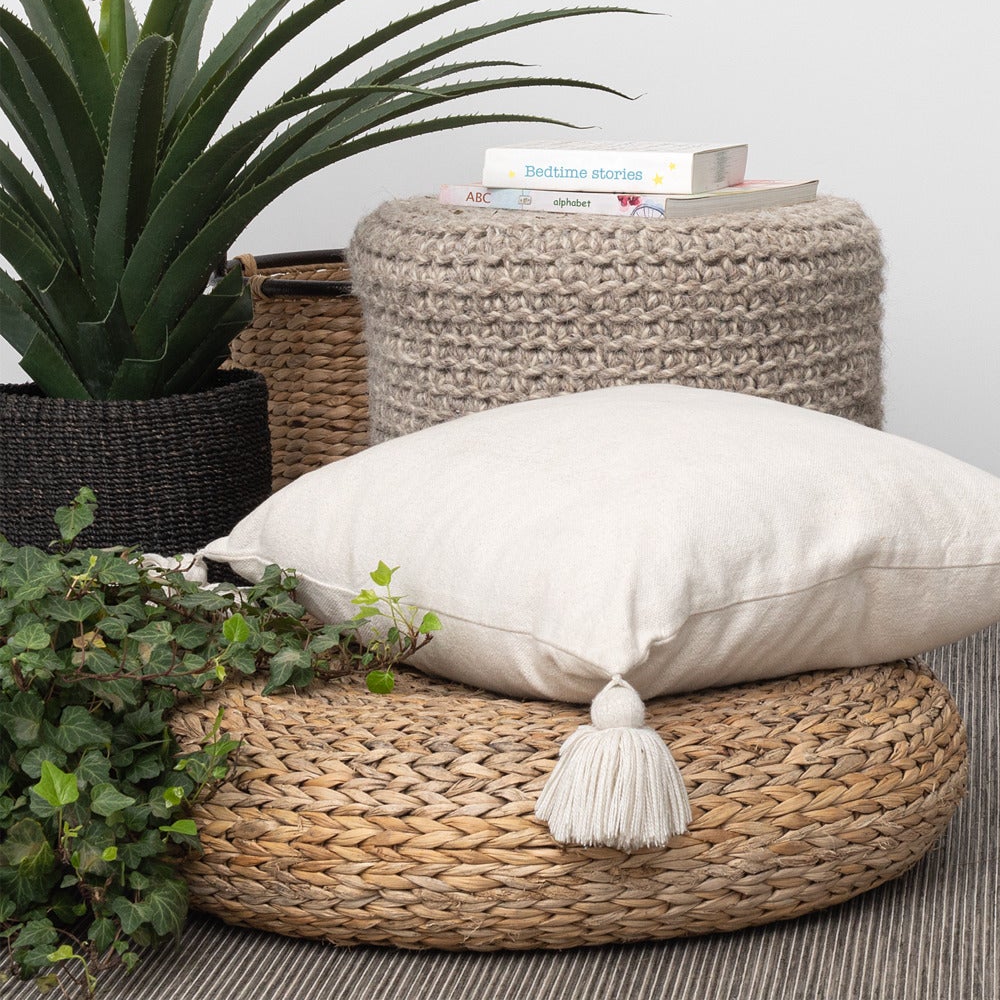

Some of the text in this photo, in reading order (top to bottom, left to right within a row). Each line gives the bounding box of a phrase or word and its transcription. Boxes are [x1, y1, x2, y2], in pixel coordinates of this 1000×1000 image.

[525, 165, 643, 180] Bedtime stories
[465, 191, 591, 208] ABC alphabet
